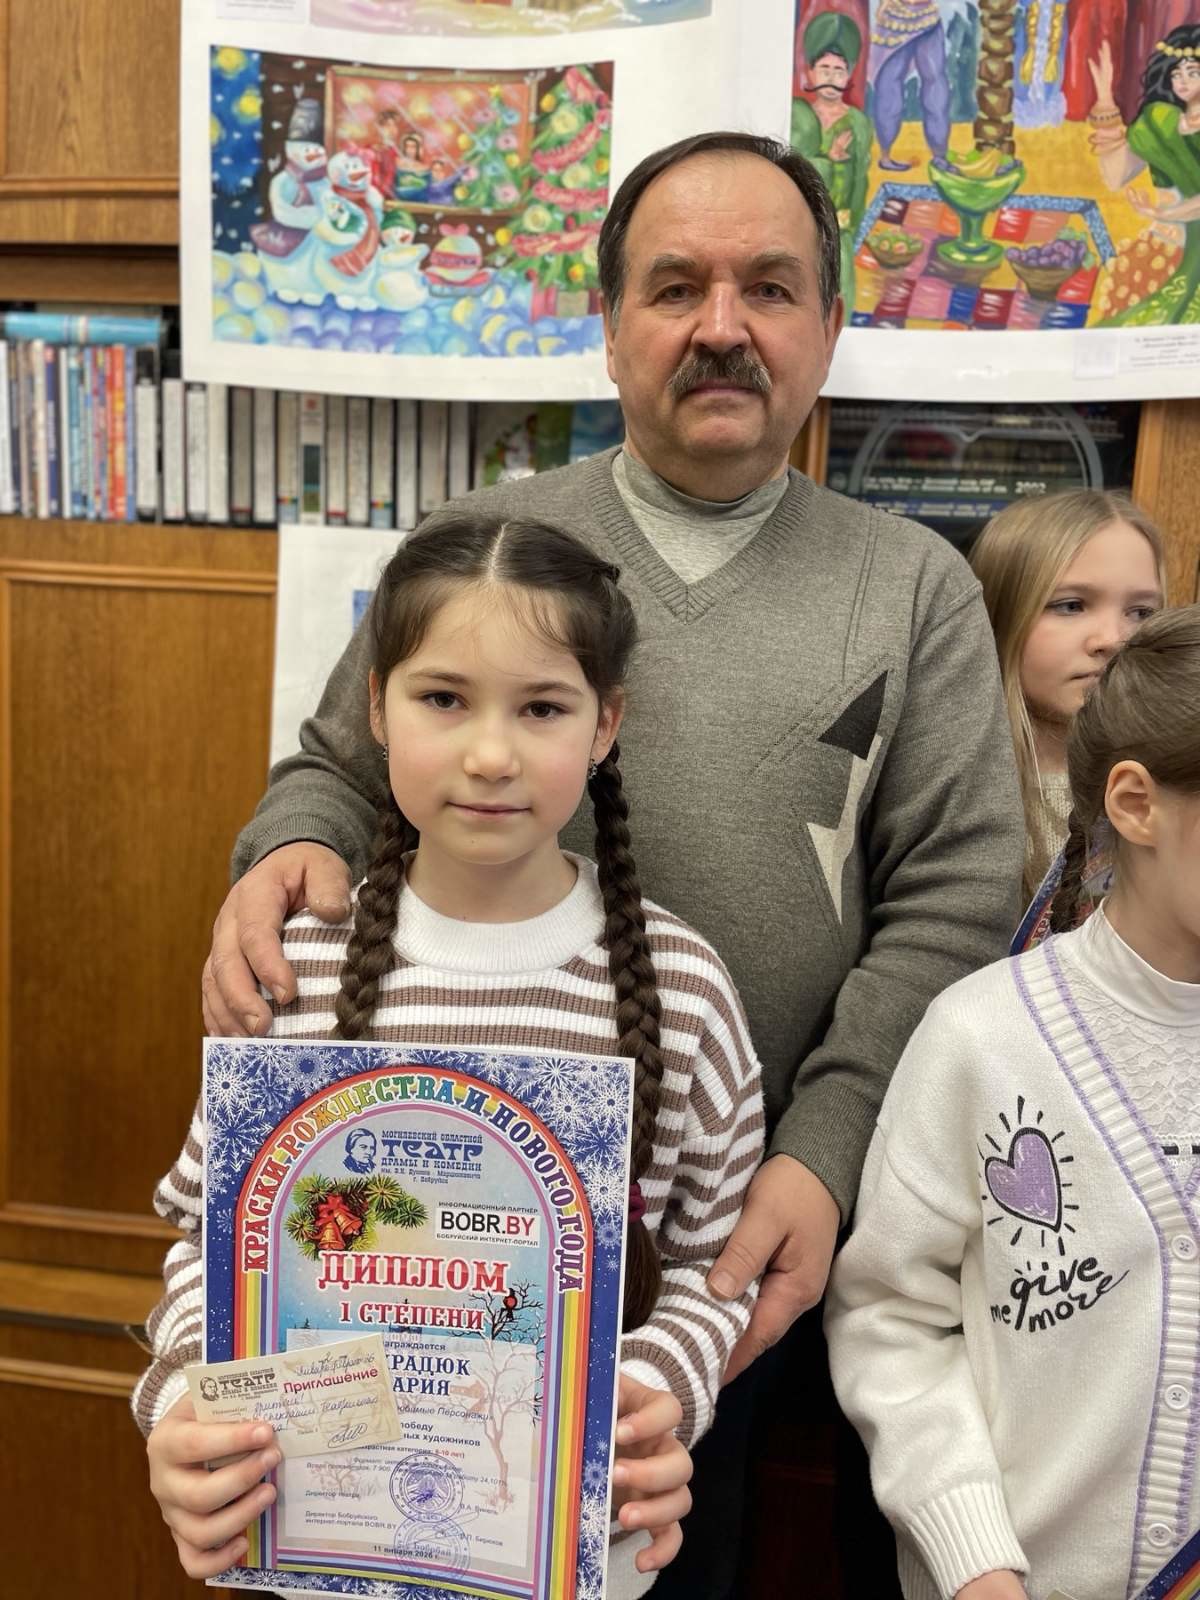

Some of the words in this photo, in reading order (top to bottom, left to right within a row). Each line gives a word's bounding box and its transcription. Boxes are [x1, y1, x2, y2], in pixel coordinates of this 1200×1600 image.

[381, 1129, 437, 1141] МОГИЛЕВСКИЙ
[440, 1133, 483, 1144] ОБЛАСТНОЙ
[381, 1139, 484, 1161] ТЕАТР
[381, 1157, 418, 1168] ДРАМЫ
[422, 1160, 429, 1168] И
[434, 1160, 482, 1171] КОМЕДИИ
[243, 1156, 291, 1272] КРАСКИ
[277, 1075, 455, 1159] РОЖДЕСТВА
[461, 1086, 490, 1116] И
[488, 1102, 575, 1208] НОВОГО
[554, 1213, 585, 1292] ГОДА
[438, 1201, 508, 1212] ИНФОРМАЦИОННЫЙ
[508, 1206, 538, 1214] ПАРТНЁР
[441, 1211, 535, 1236] BOBR.BY
[436, 1233, 479, 1241] БОБРУЙСКИЙ
[480, 1236, 538, 1246] ИНТЕРНЕТ-ПОРТАЛ
[318, 1253, 509, 1294] ДИПЛОМ
[1010, 1257, 1104, 1331] give
[1028, 1269, 1131, 1333] more
[359, 1303, 485, 1331] СТЕПЕНИ
[990, 1303, 1012, 1325] me
[382, 1340, 446, 1352] аграждается
[385, 1353, 471, 1376] РАДЮК
[218, 1373, 276, 1390] ТЕАТР
[283, 1368, 379, 1395] Приглашение
[392, 1376, 451, 1396] АРИЯ
[397, 1405, 436, 1415] юбимые
[403, 1432, 420, 1440] ных
[422, 1433, 481, 1447] художников
[373, 1545, 381, 1553] 11
[383, 1547, 413, 1557] января
[415, 1550, 433, 1559] 2026
